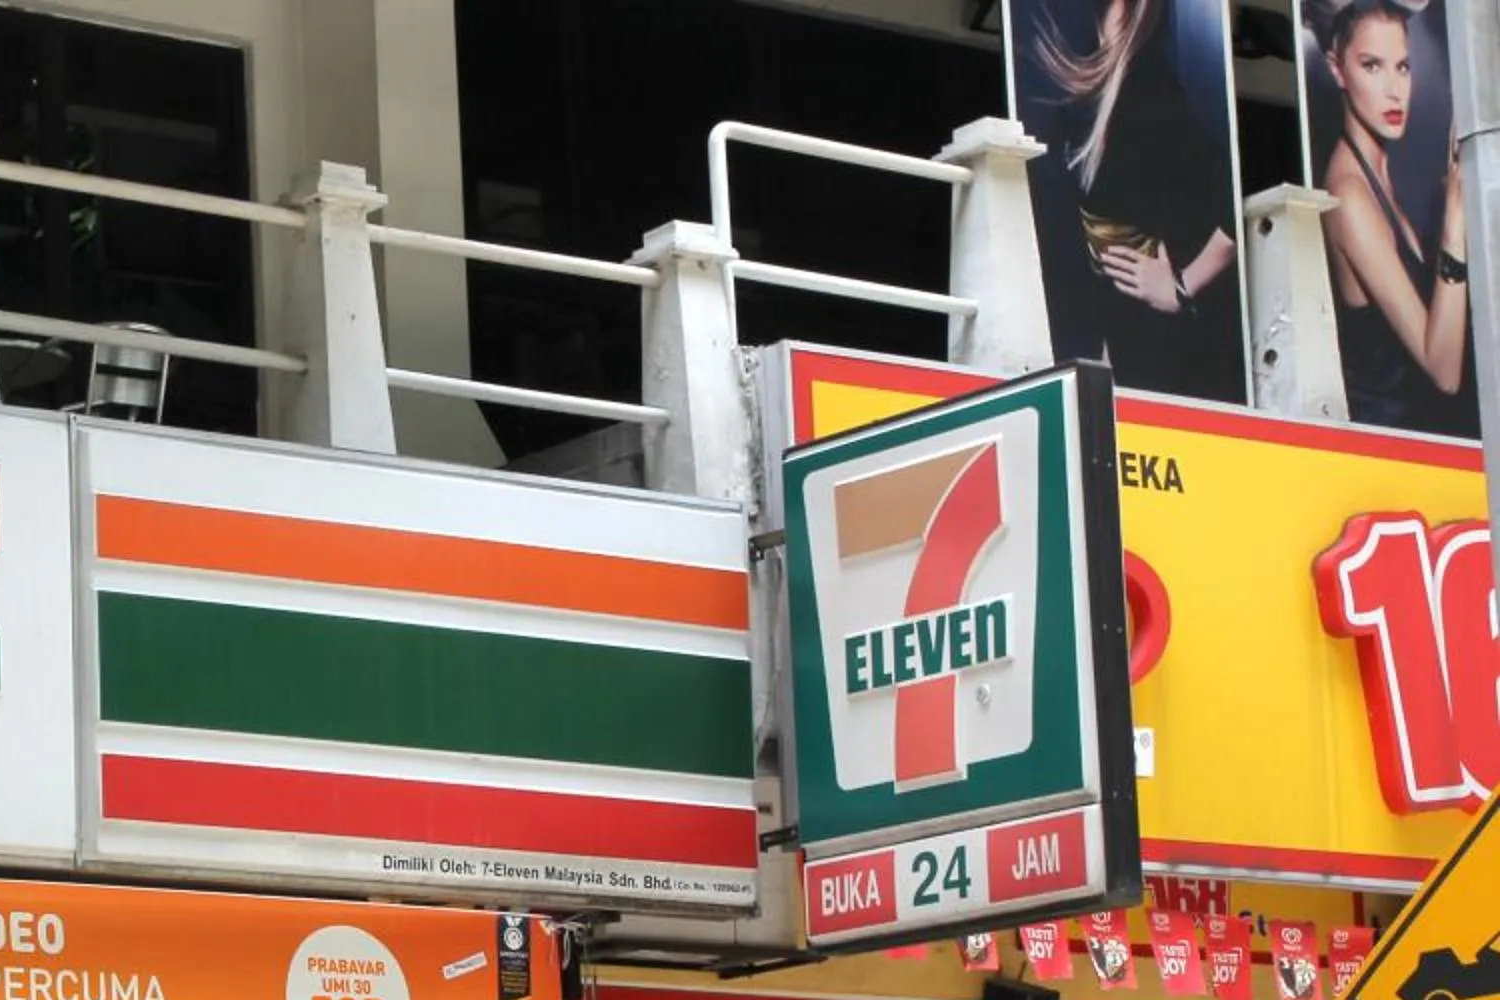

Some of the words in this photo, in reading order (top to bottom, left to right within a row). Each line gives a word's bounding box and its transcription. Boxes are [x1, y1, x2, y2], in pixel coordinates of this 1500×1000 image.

[834, 442, 1003, 782] 7
[383, 855, 434, 873] Dimiliki
[440, 858, 477, 875] Oleh:
[482, 861, 540, 880] 7-Eleven
[544, 865, 603, 886] Malaysia
[609, 871, 639, 888] Sdn.
[821, 868, 881, 917] BUKA
[912, 844, 972, 907] 24
[1012, 832, 1061, 881] JAM
[1026, 940, 1054, 958] JOY
[307, 956, 386, 977] PRABAYAR
[323, 978, 351, 994] UMI
[354, 979, 372, 995] 30
